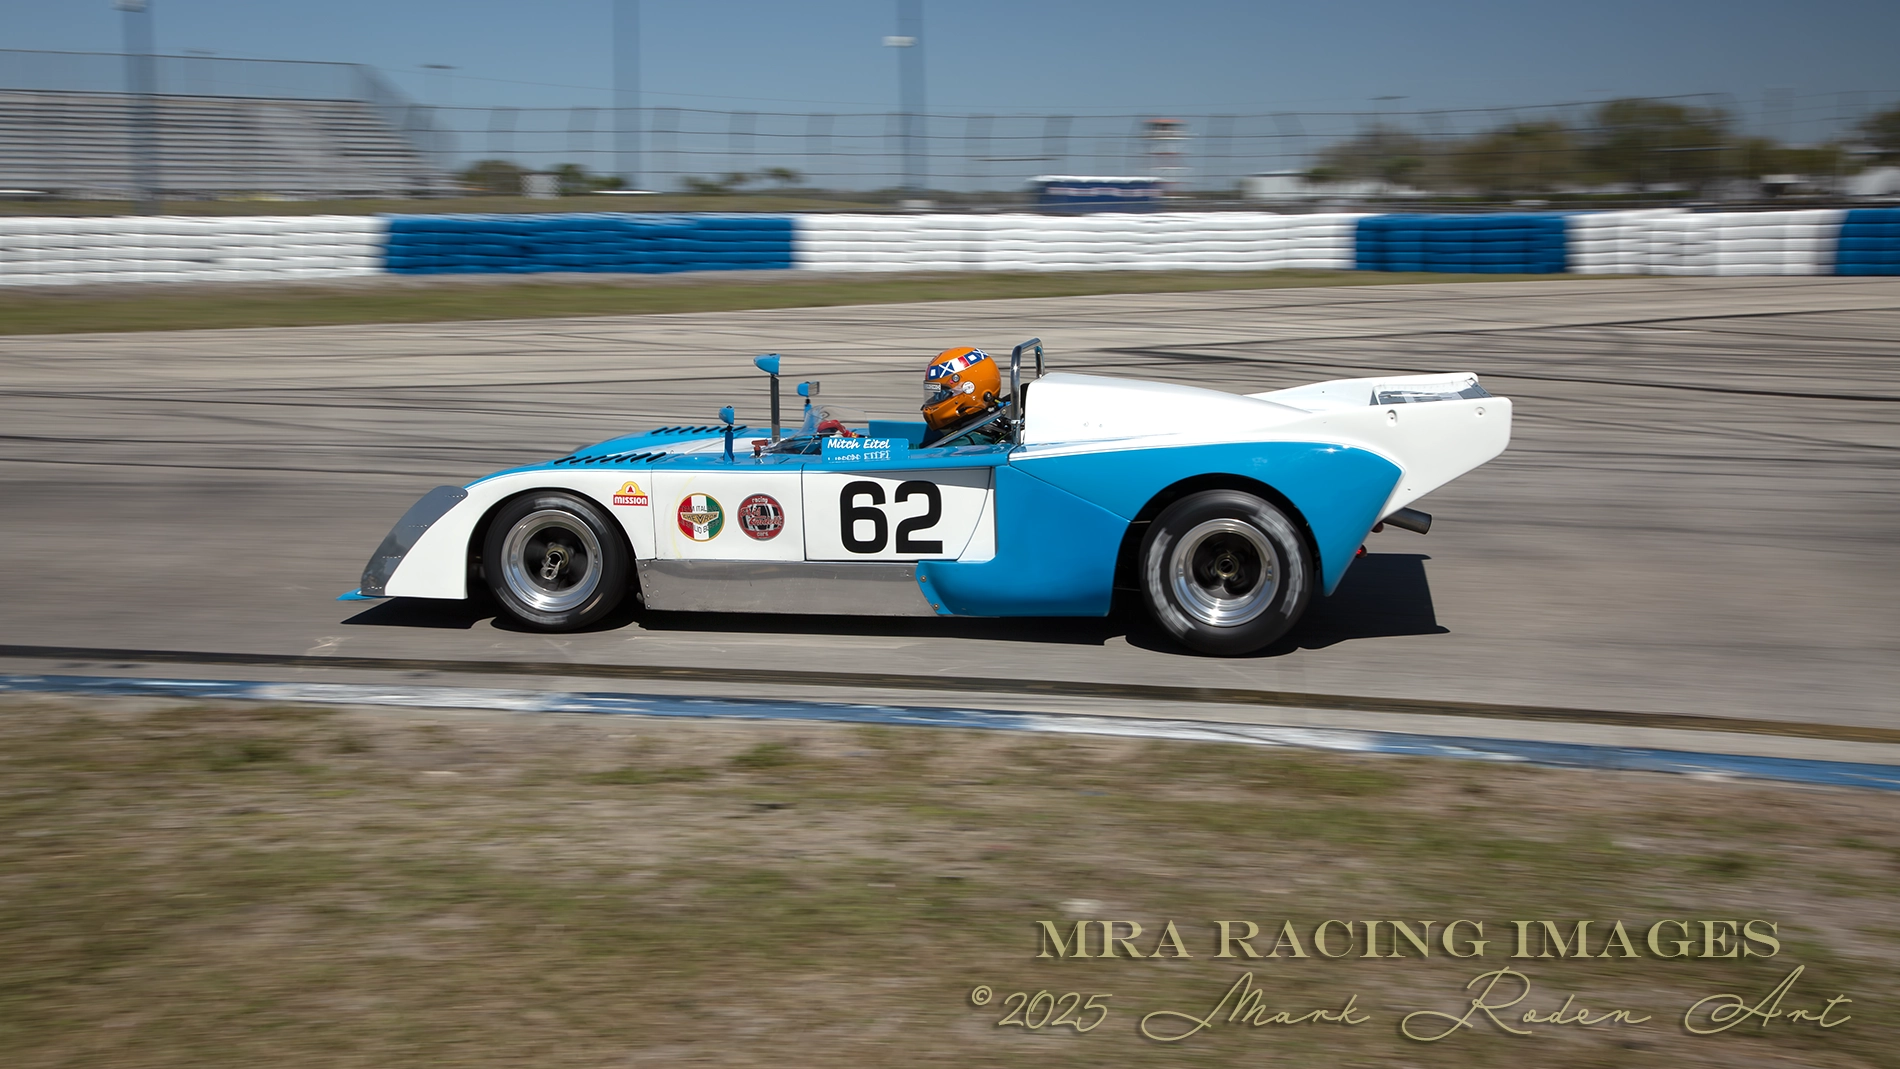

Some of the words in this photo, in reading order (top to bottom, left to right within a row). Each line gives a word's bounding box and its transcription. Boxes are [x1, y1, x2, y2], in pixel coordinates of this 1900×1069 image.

[827, 438, 860, 449] Mitch
[863, 438, 890, 449] Eitel
[614, 496, 648, 505] MISSION
[840, 480, 943, 554] 62
